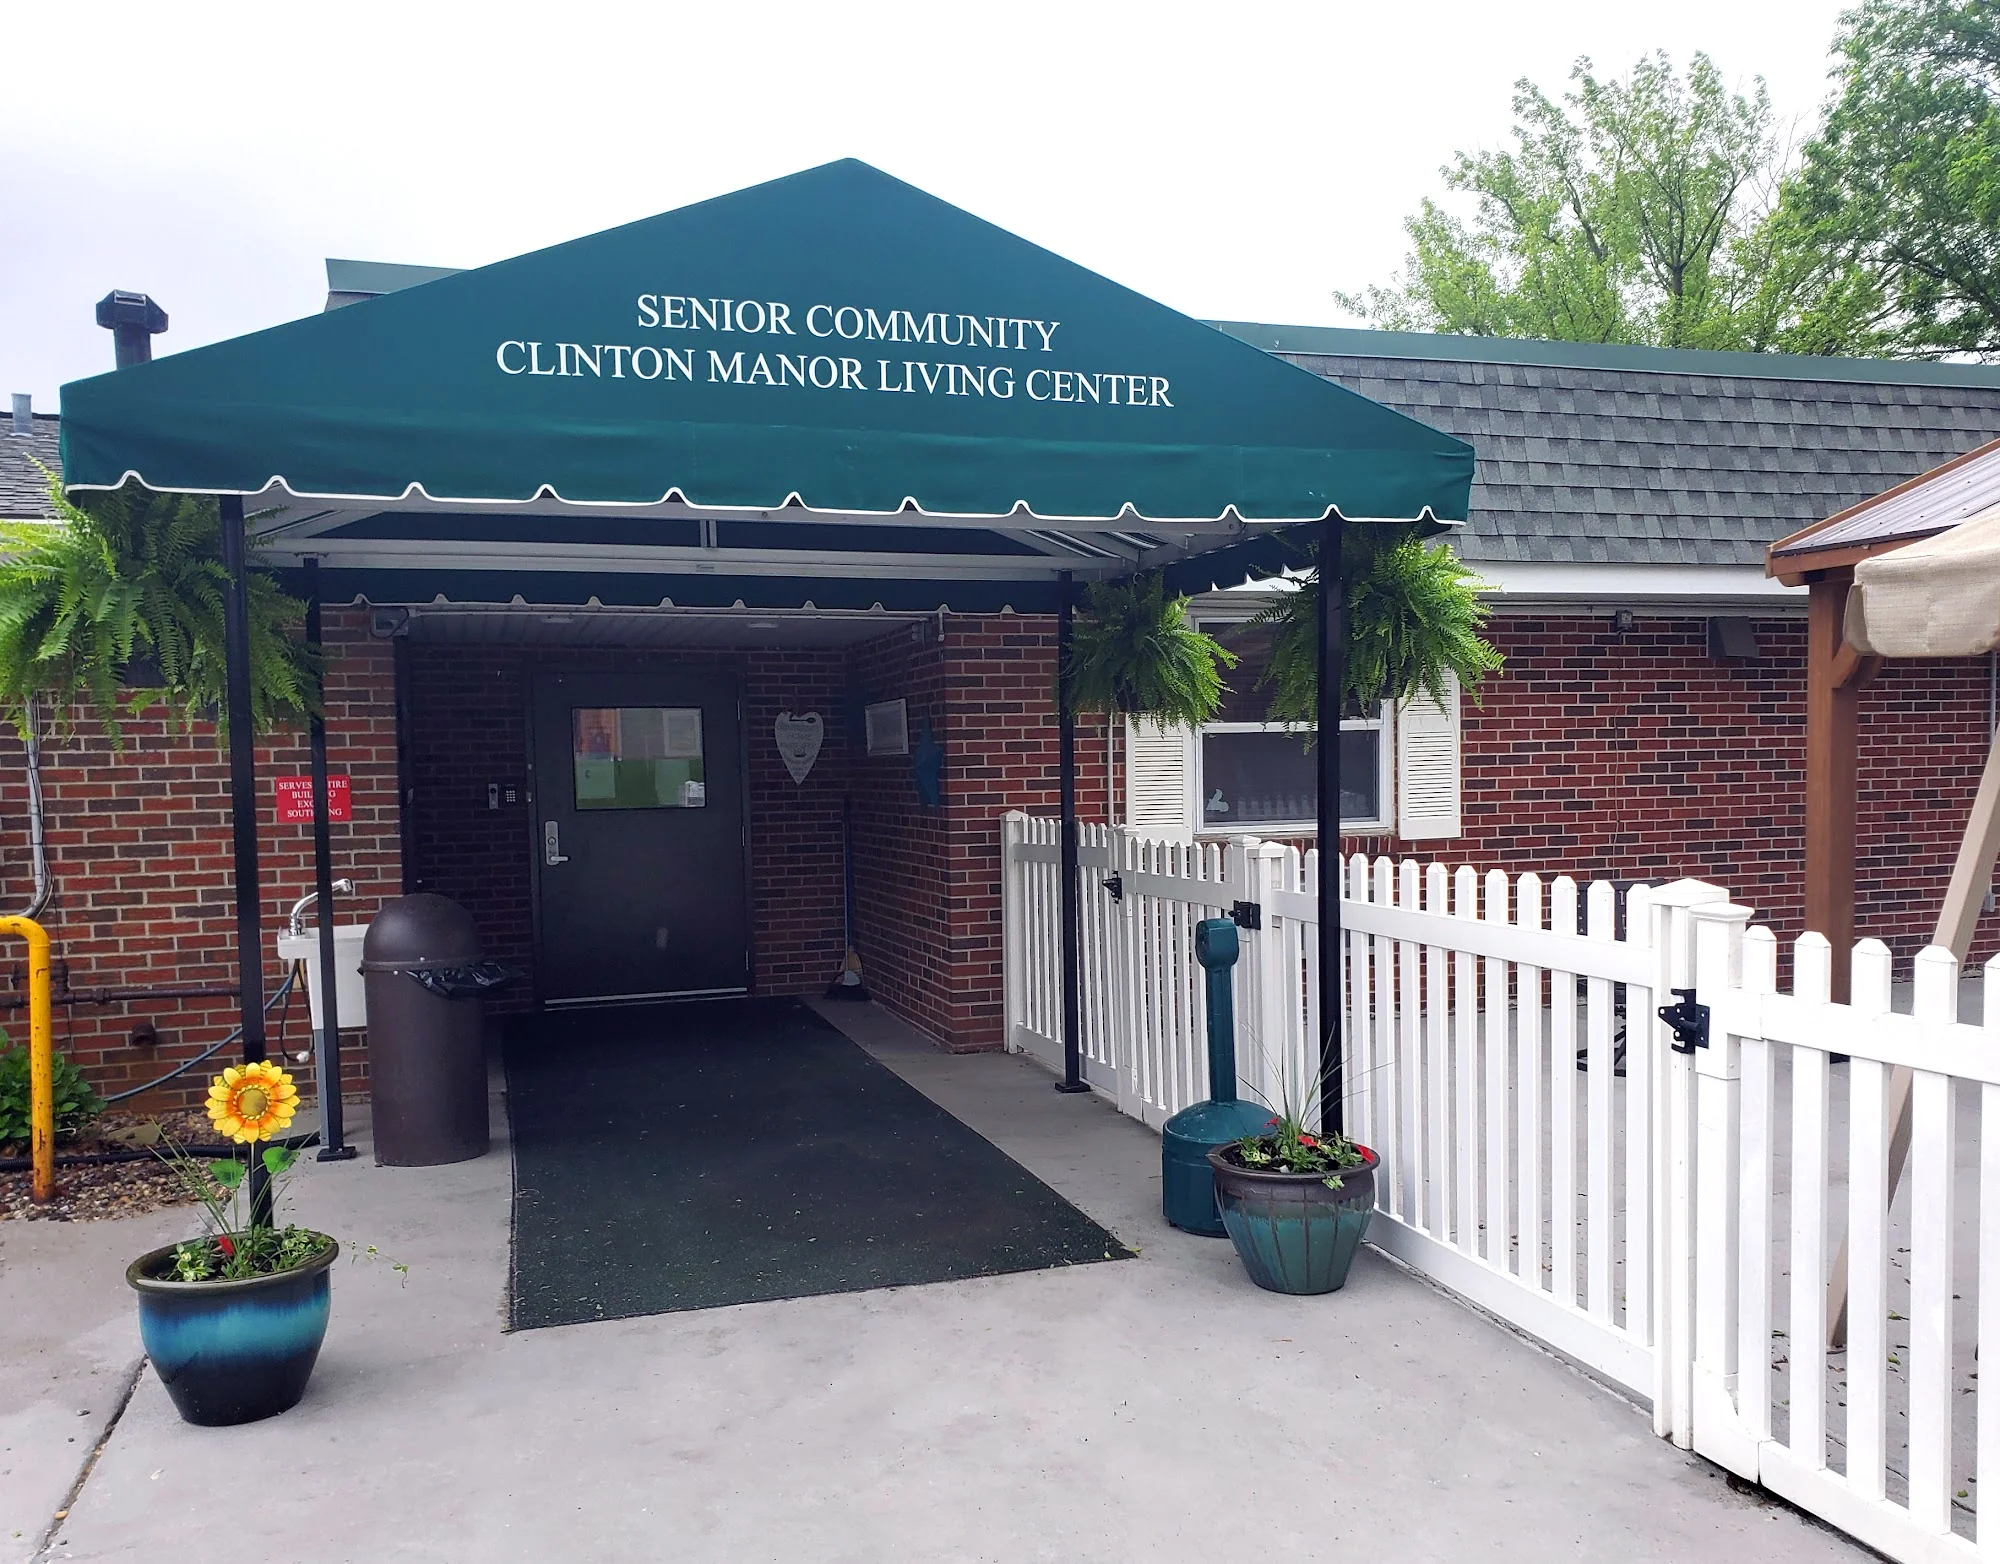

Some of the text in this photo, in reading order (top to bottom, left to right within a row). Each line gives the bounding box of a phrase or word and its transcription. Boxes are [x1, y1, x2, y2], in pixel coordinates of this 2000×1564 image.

[636, 293, 1062, 353] SENIOR COMMUNITY
[495, 339, 1175, 409] CLINTON MANOR LIVING CENTER
[278, 780, 348, 790] SERVES TIRE
[291, 790, 336, 799] BUILG
